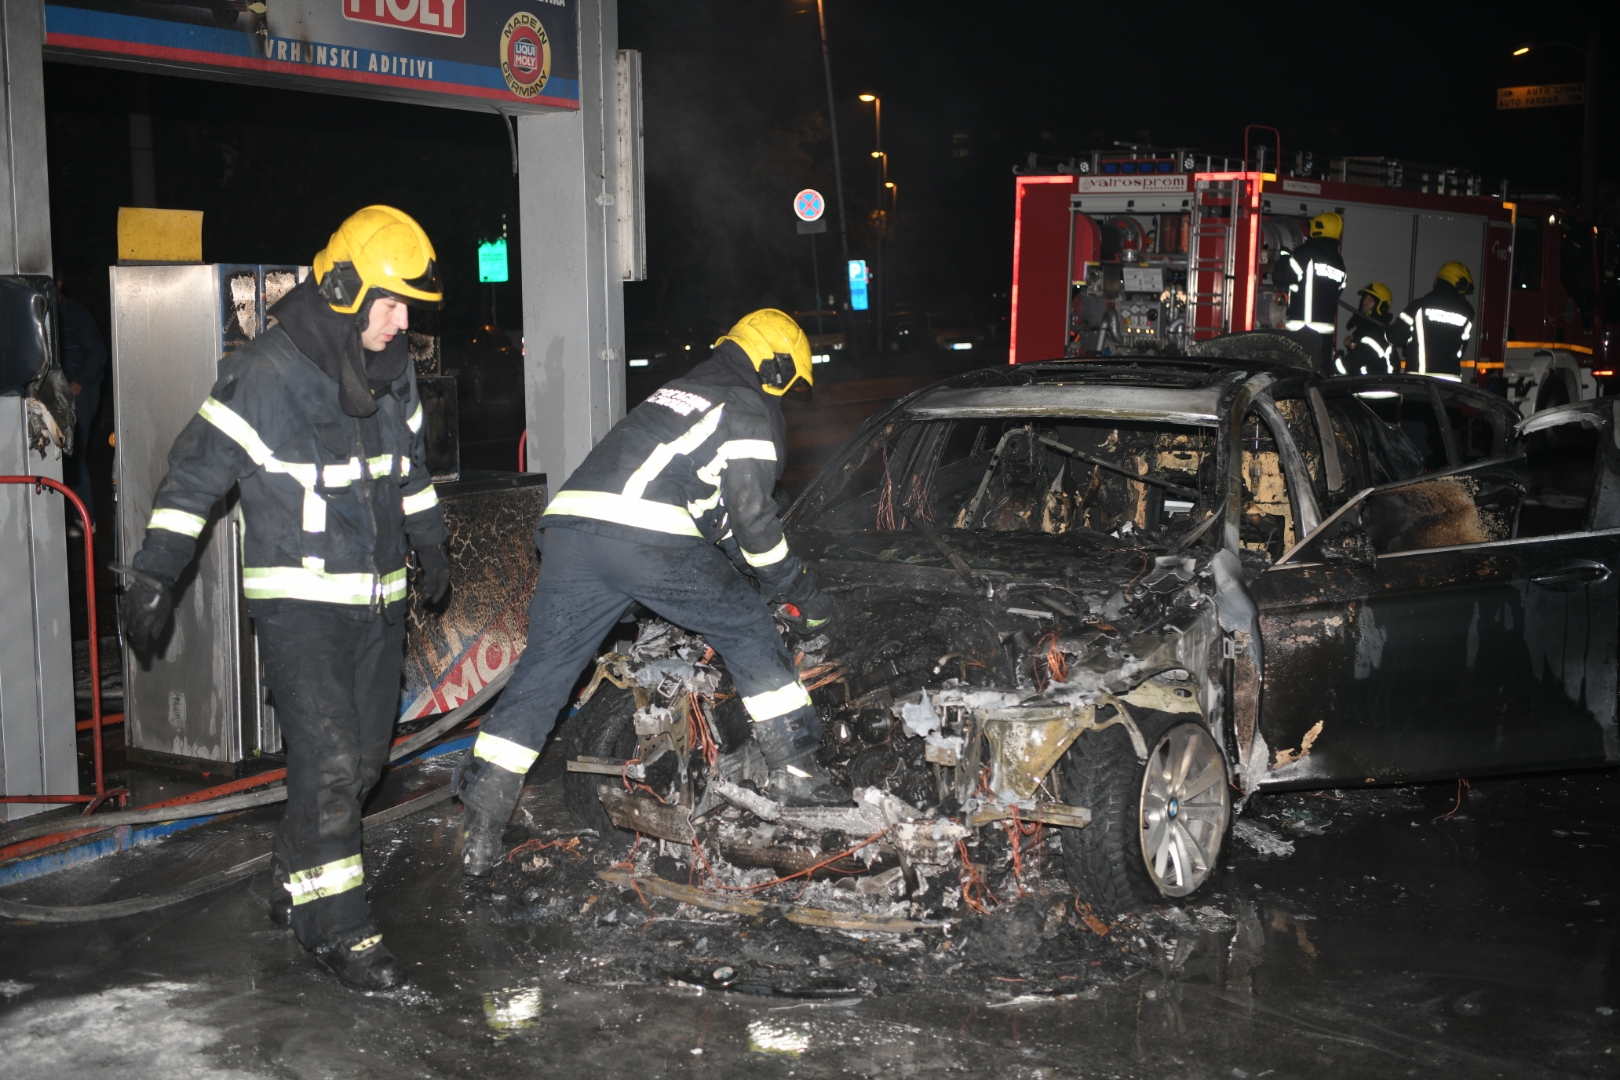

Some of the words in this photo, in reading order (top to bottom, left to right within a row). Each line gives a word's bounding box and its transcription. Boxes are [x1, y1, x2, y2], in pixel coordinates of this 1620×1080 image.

[350, 0, 456, 28] OLY
[504, 15, 538, 38] MADE
[537, 26, 547, 45] IN
[515, 43, 536, 56] LIQUI
[264, 38, 358, 69] VRHUNSKI
[368, 53, 433, 79] ADITIVI
[515, 55, 536, 67] MOLY
[502, 61, 547, 97] GERMANY
[1526, 87, 1550, 96] AUTO
[1554, 84, 1583, 94] LIMAR
[1499, 99, 1521, 107] AUTO
[1526, 96, 1558, 106] FARBAR
[850, 262, 862, 279] P
